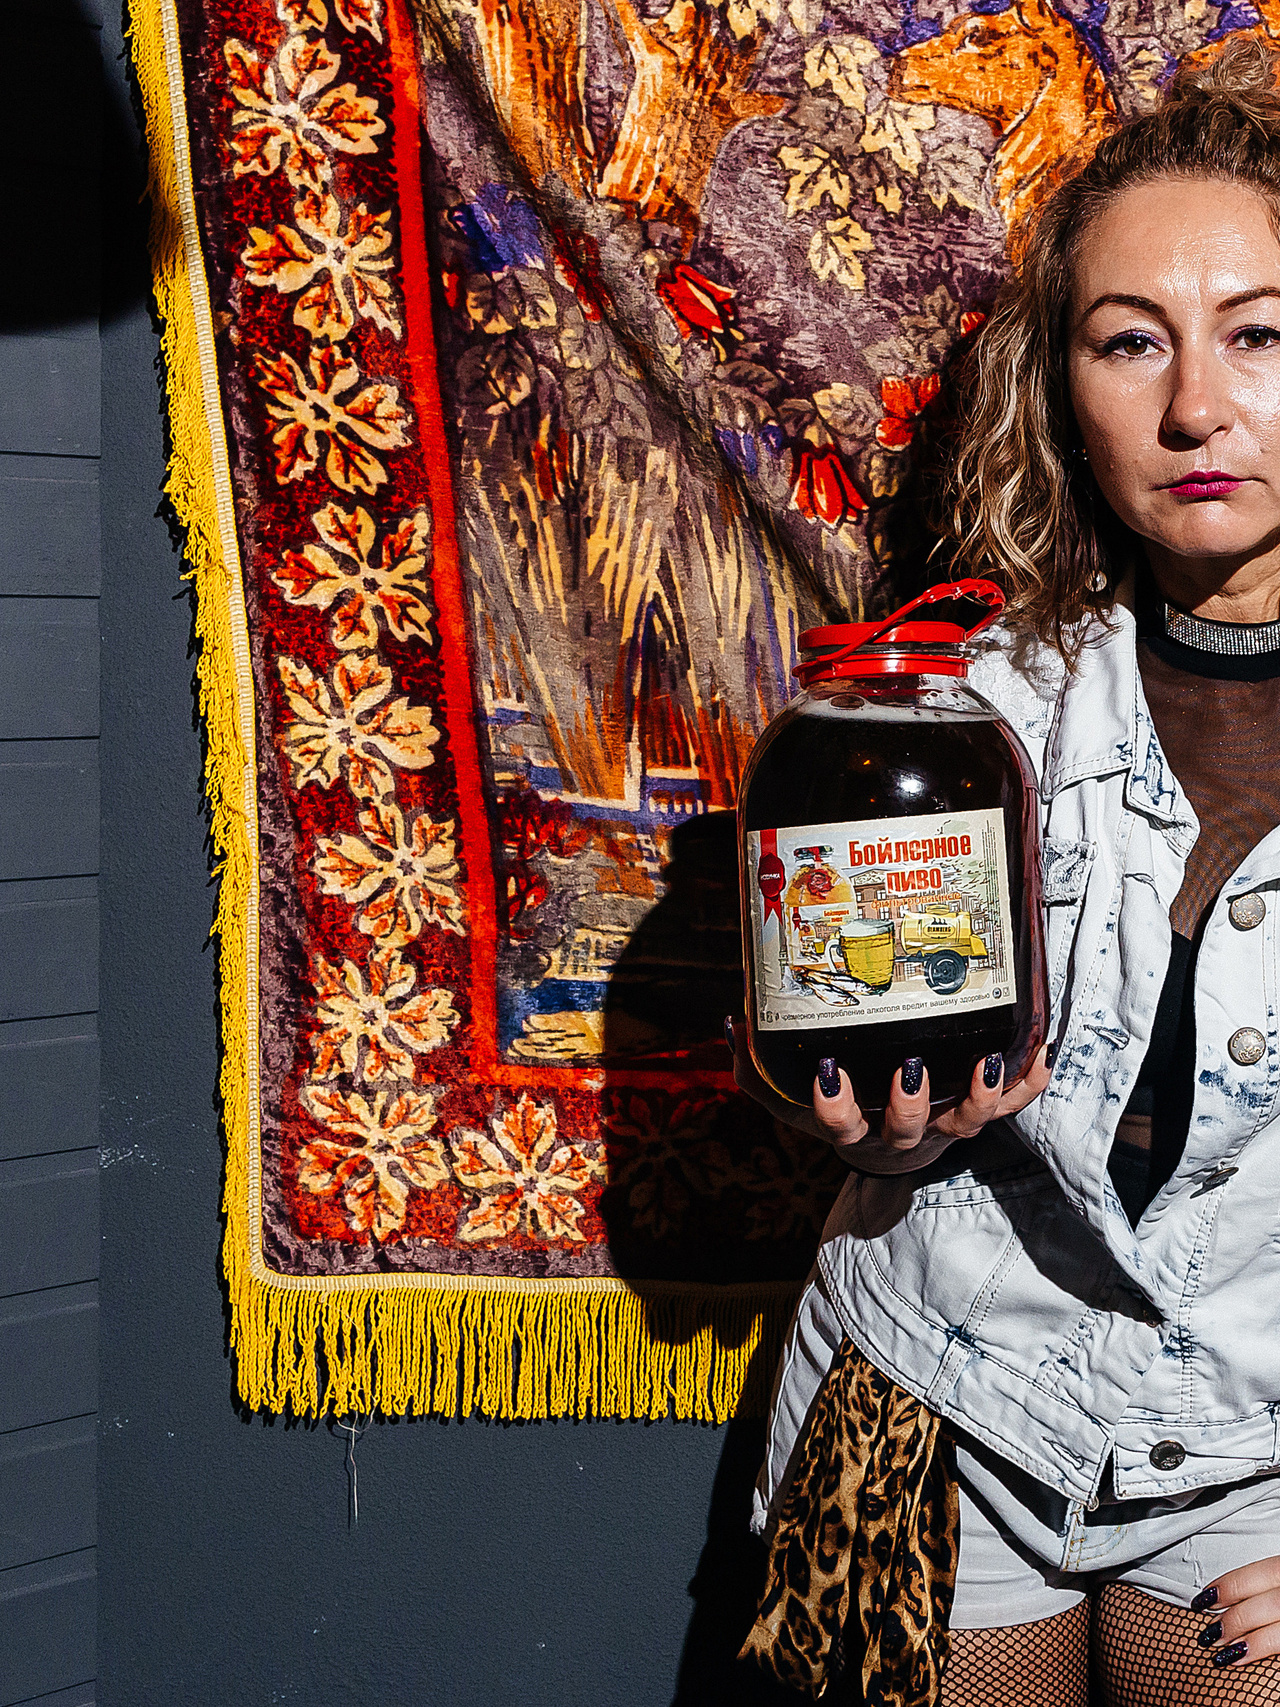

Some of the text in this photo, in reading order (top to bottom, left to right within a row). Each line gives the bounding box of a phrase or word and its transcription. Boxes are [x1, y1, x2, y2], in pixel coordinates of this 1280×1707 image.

[848, 834, 972, 867] Бойлерное
[886, 868, 942, 894] пиво
[816, 1008, 865, 1020] употребление
[866, 1004, 900, 1015] алкоголя
[901, 1002, 928, 1012] вредит
[929, 996, 959, 1008] вашему
[959, 992, 991, 1005] здоровью
